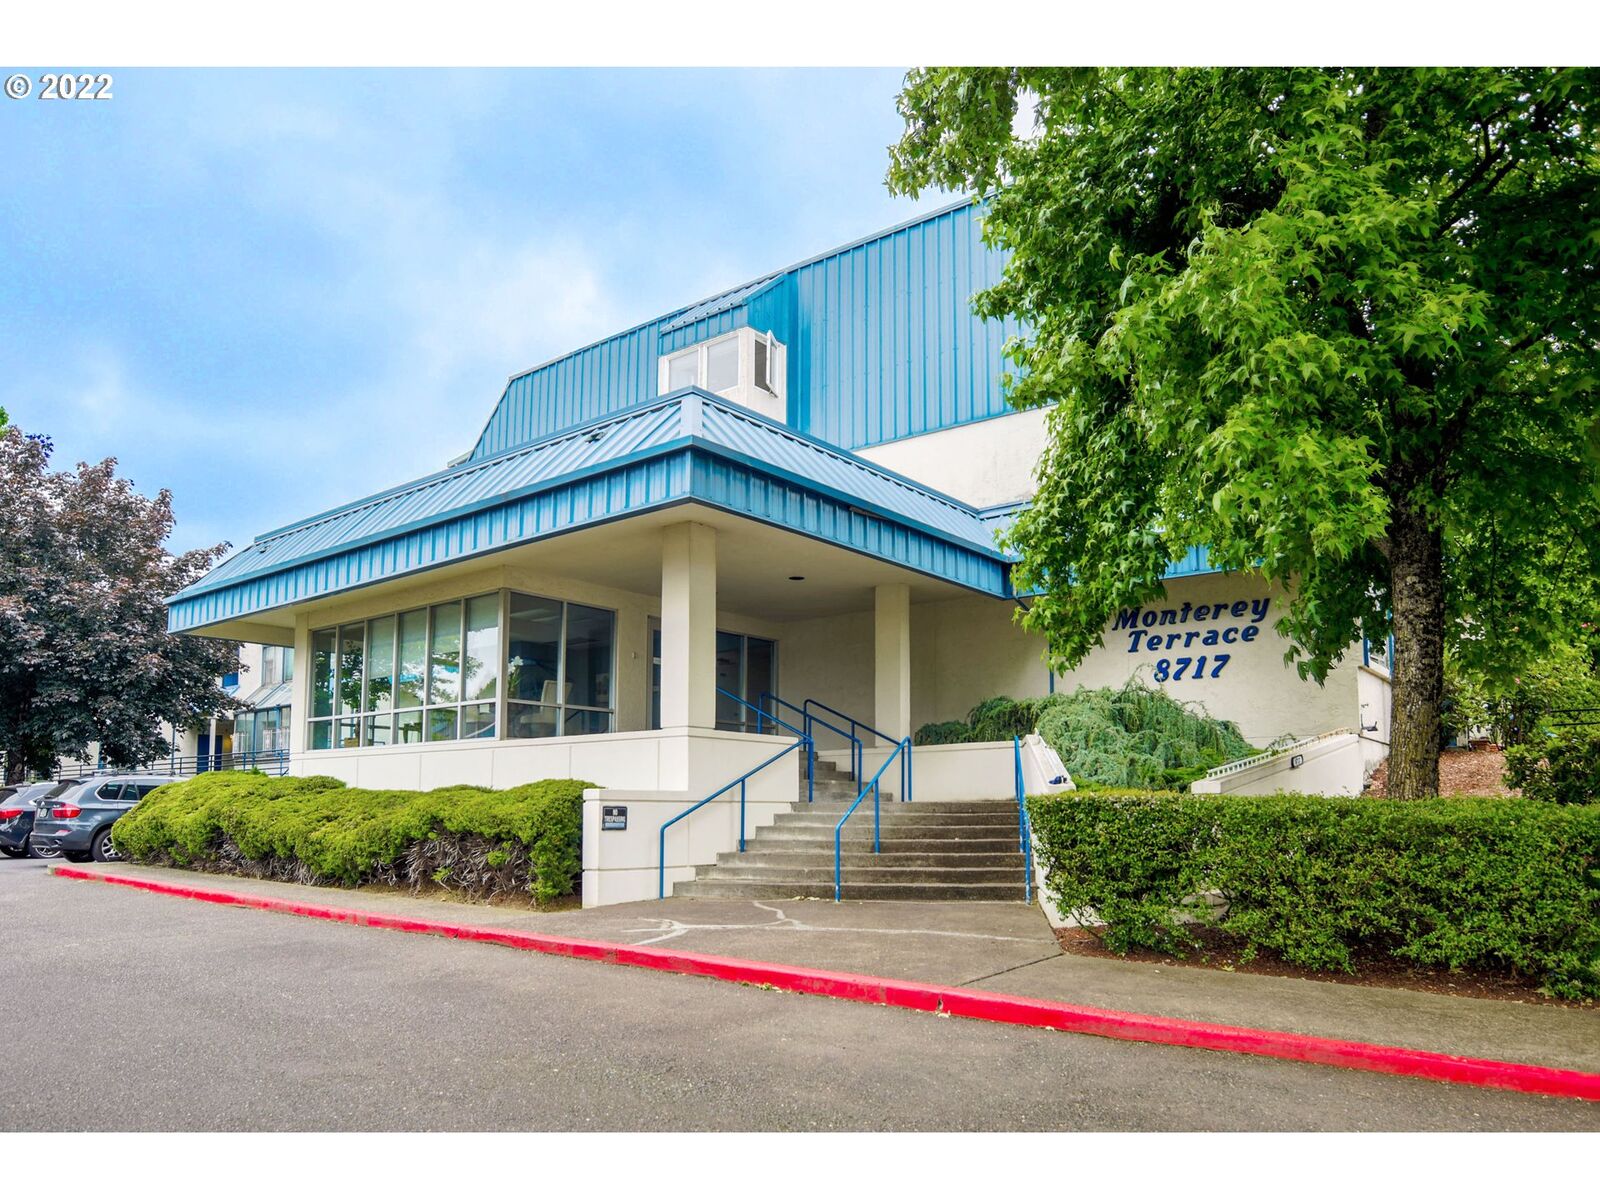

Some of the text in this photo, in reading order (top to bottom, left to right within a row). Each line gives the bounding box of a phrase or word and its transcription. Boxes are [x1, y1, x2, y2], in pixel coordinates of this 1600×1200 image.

[1112, 598, 1270, 630] Monterey
[1127, 625, 1260, 653] Terrace
[1153, 653, 1231, 683] 8717
